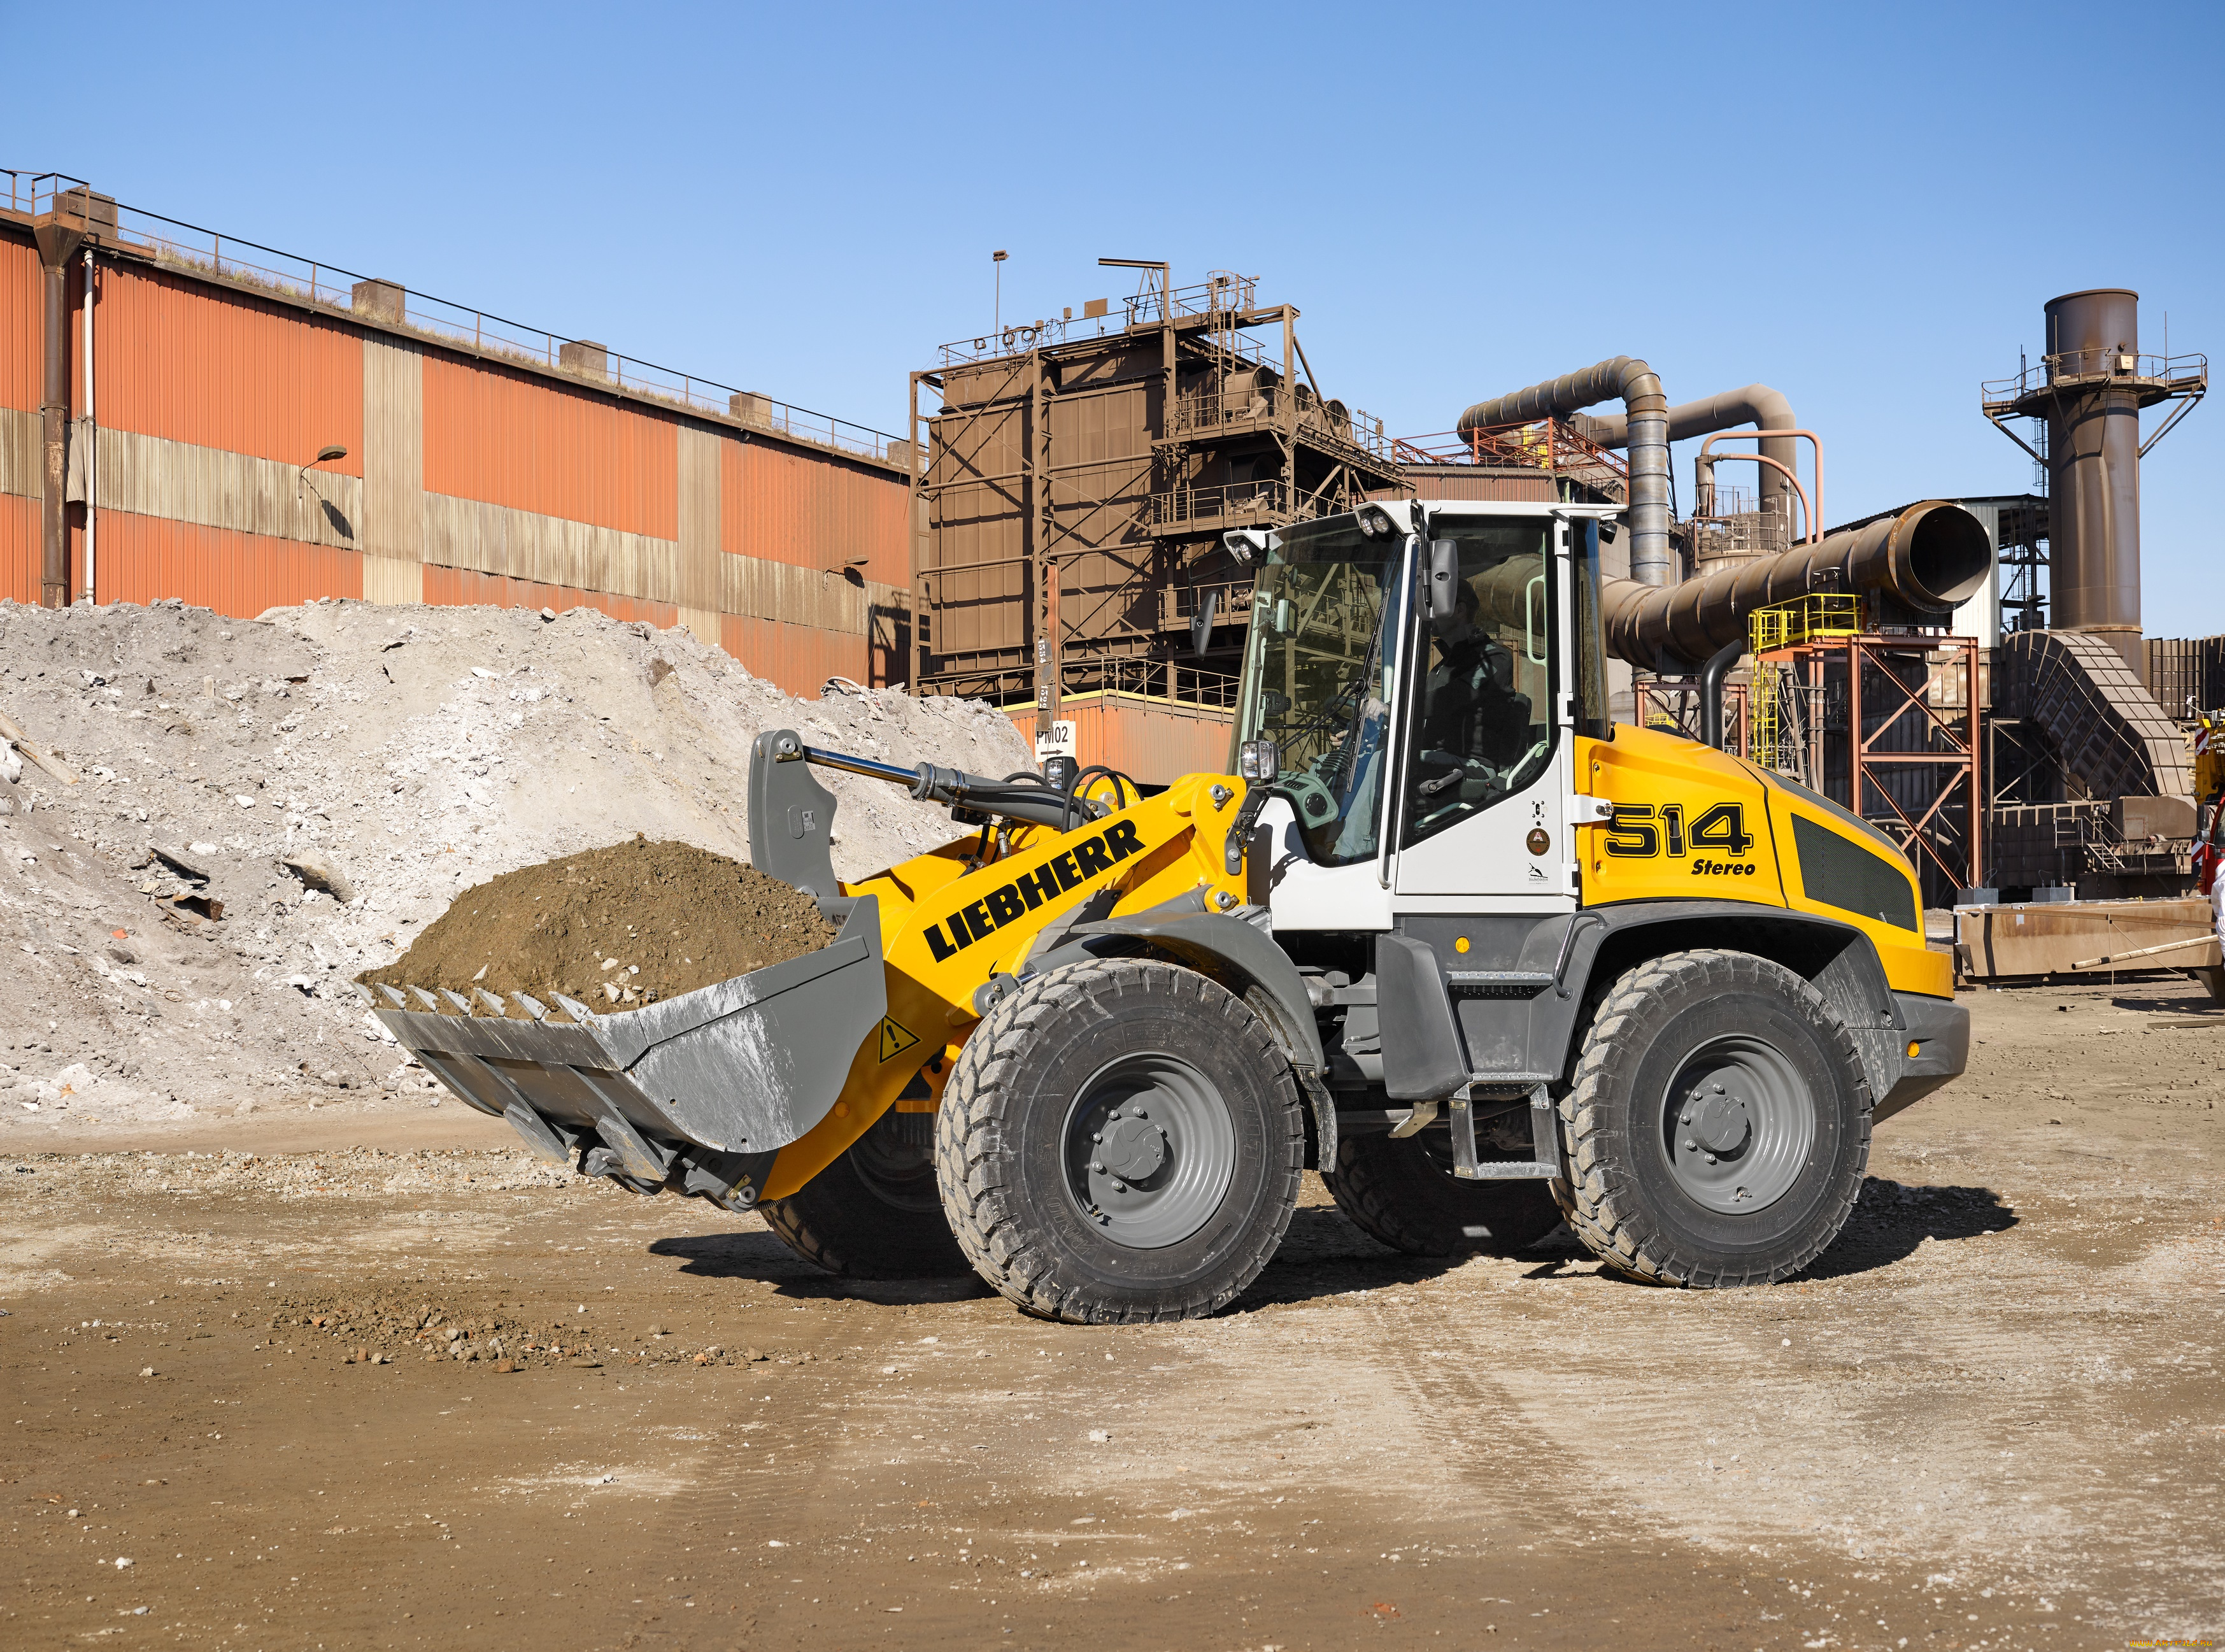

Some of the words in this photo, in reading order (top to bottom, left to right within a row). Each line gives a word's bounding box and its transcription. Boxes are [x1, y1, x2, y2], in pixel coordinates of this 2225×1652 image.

[1039, 685, 1048, 708] 1322
[1037, 725, 1068, 744] PM02
[1604, 802, 1754, 858] 514
[923, 819, 1146, 963] LIEBHERR
[1691, 858, 1756, 876] Stereo
[1665, 1009, 1722, 1057] VJT
[1234, 1086, 1262, 1168] VJT
[1037, 1074, 1091, 1255] BRIDGESTONE
[1710, 1144, 1833, 1239] BRIDGESTONE
